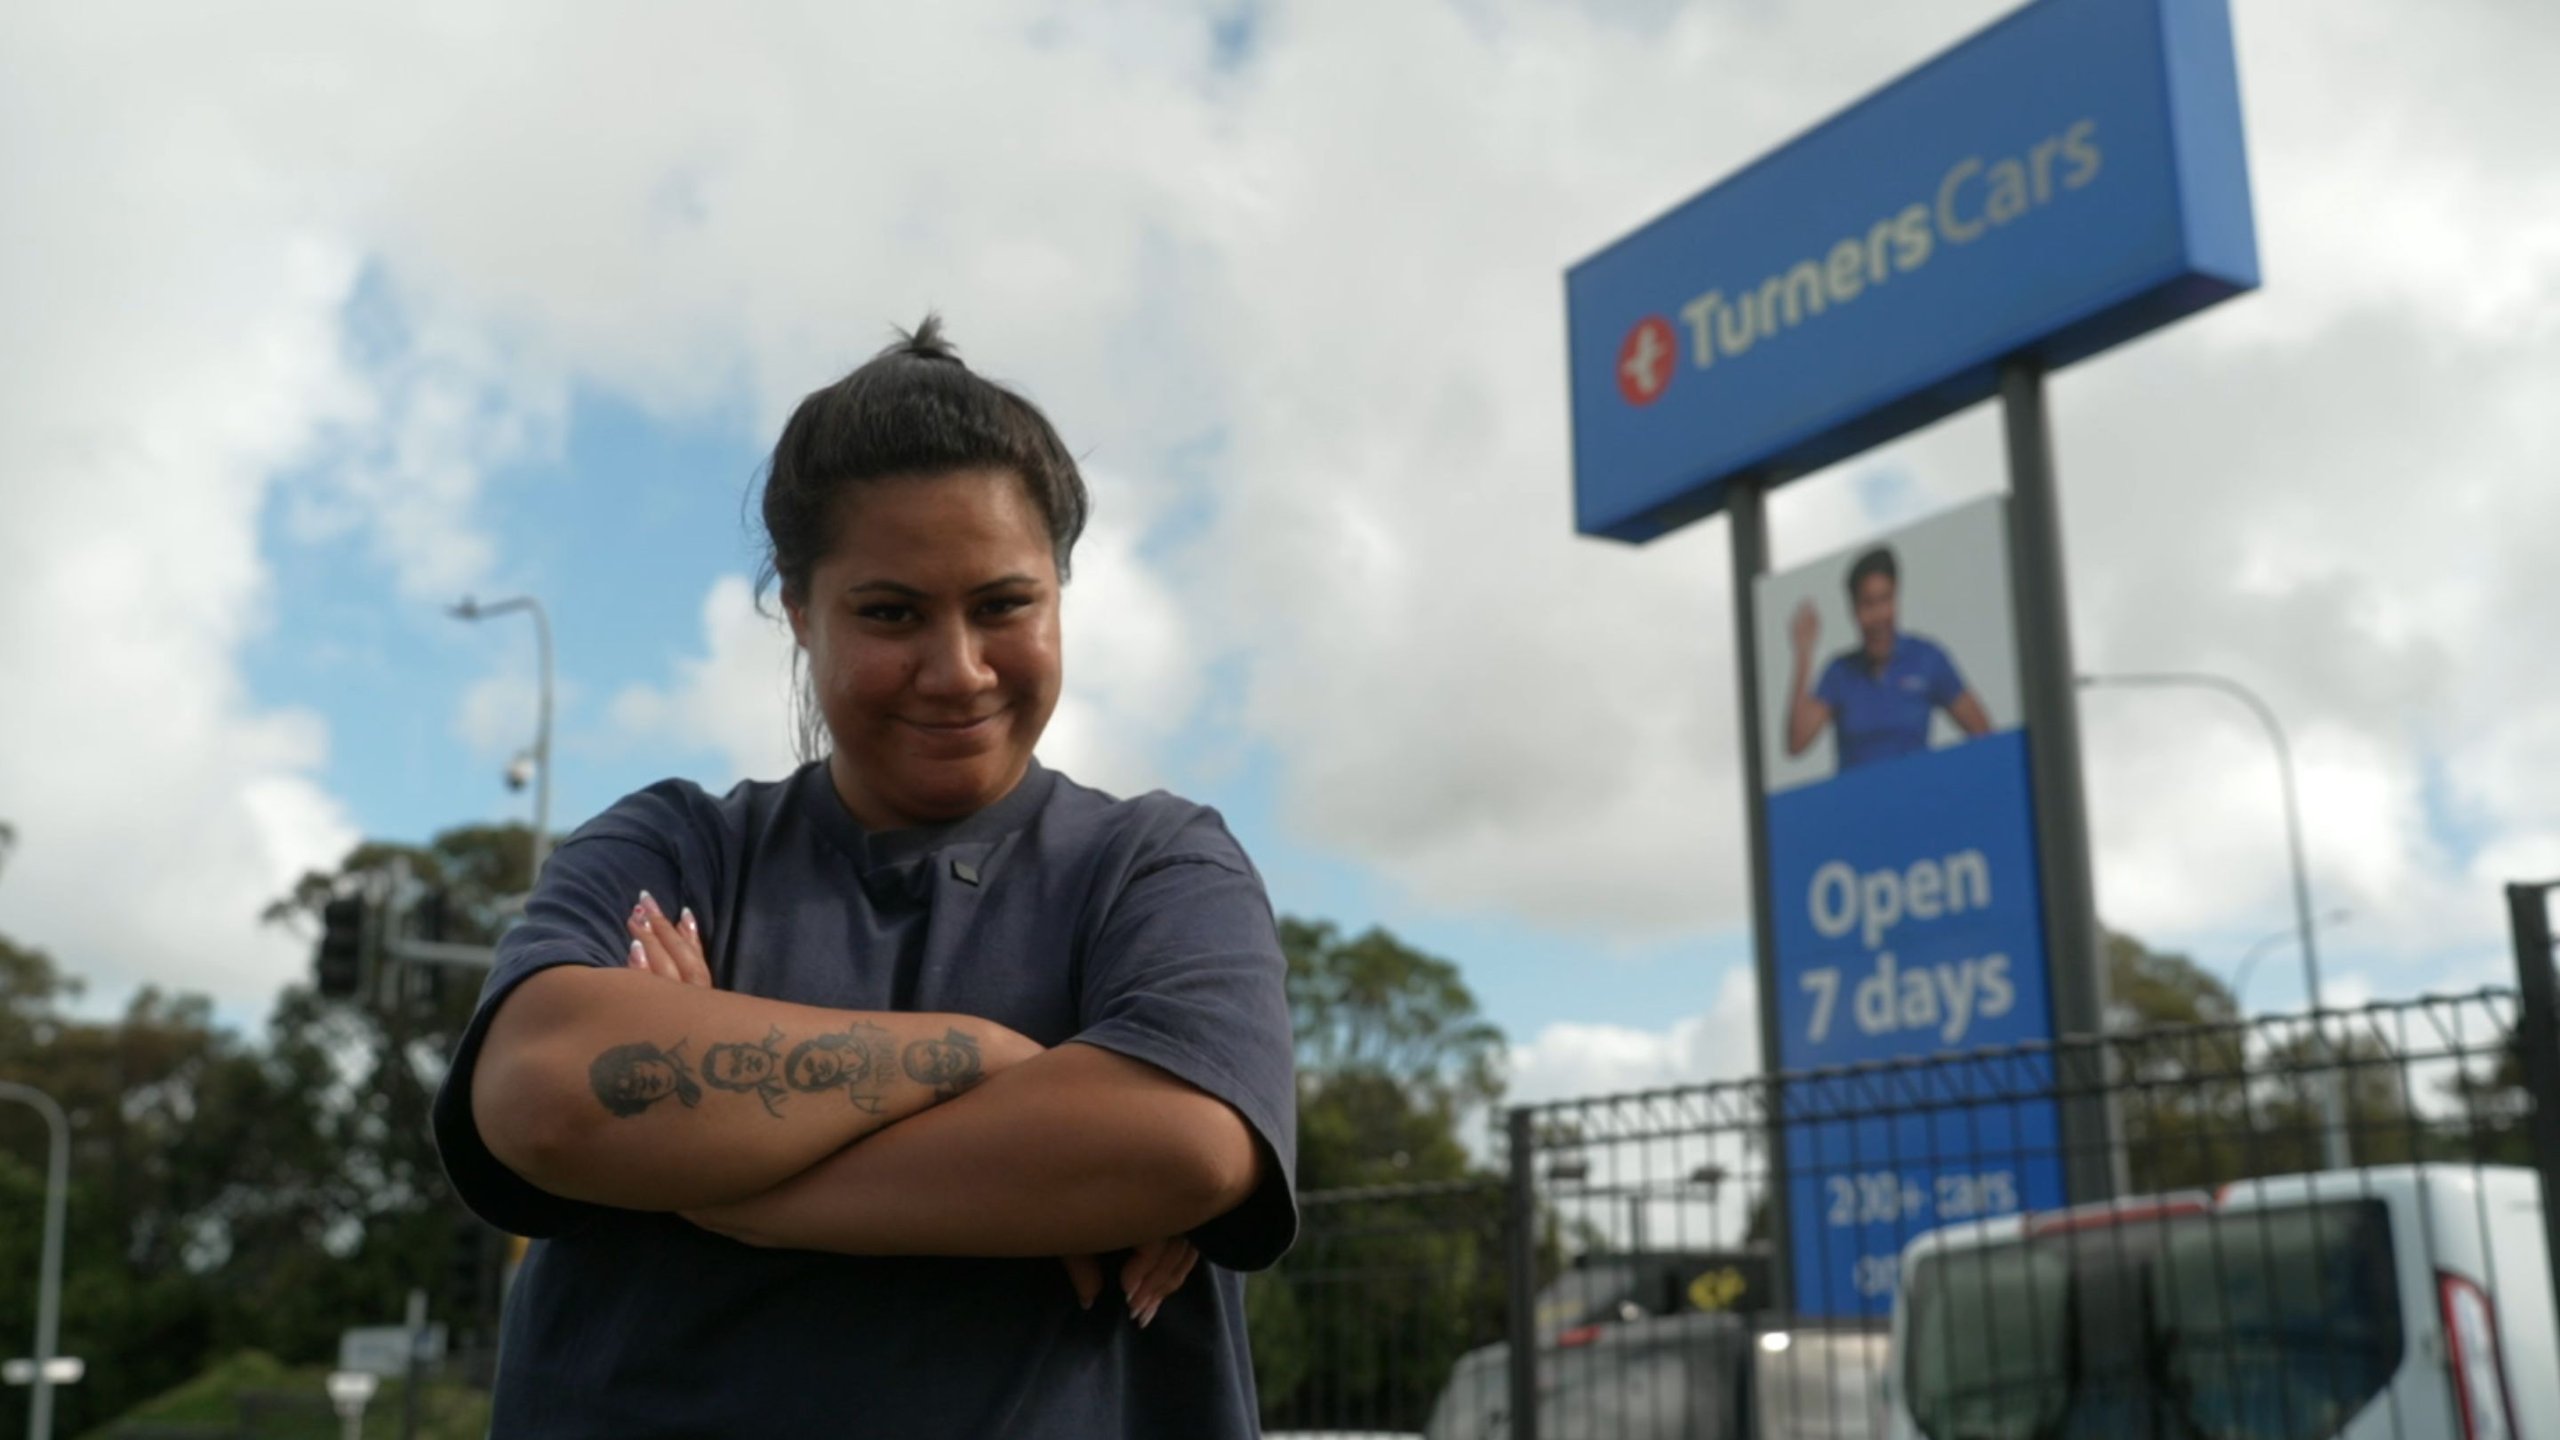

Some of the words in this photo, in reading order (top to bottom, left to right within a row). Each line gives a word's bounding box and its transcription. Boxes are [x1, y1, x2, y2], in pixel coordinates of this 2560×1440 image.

[1808, 848, 1991, 949] Open
[1800, 966, 1842, 1043] 7
[1853, 951, 2015, 1044] days
